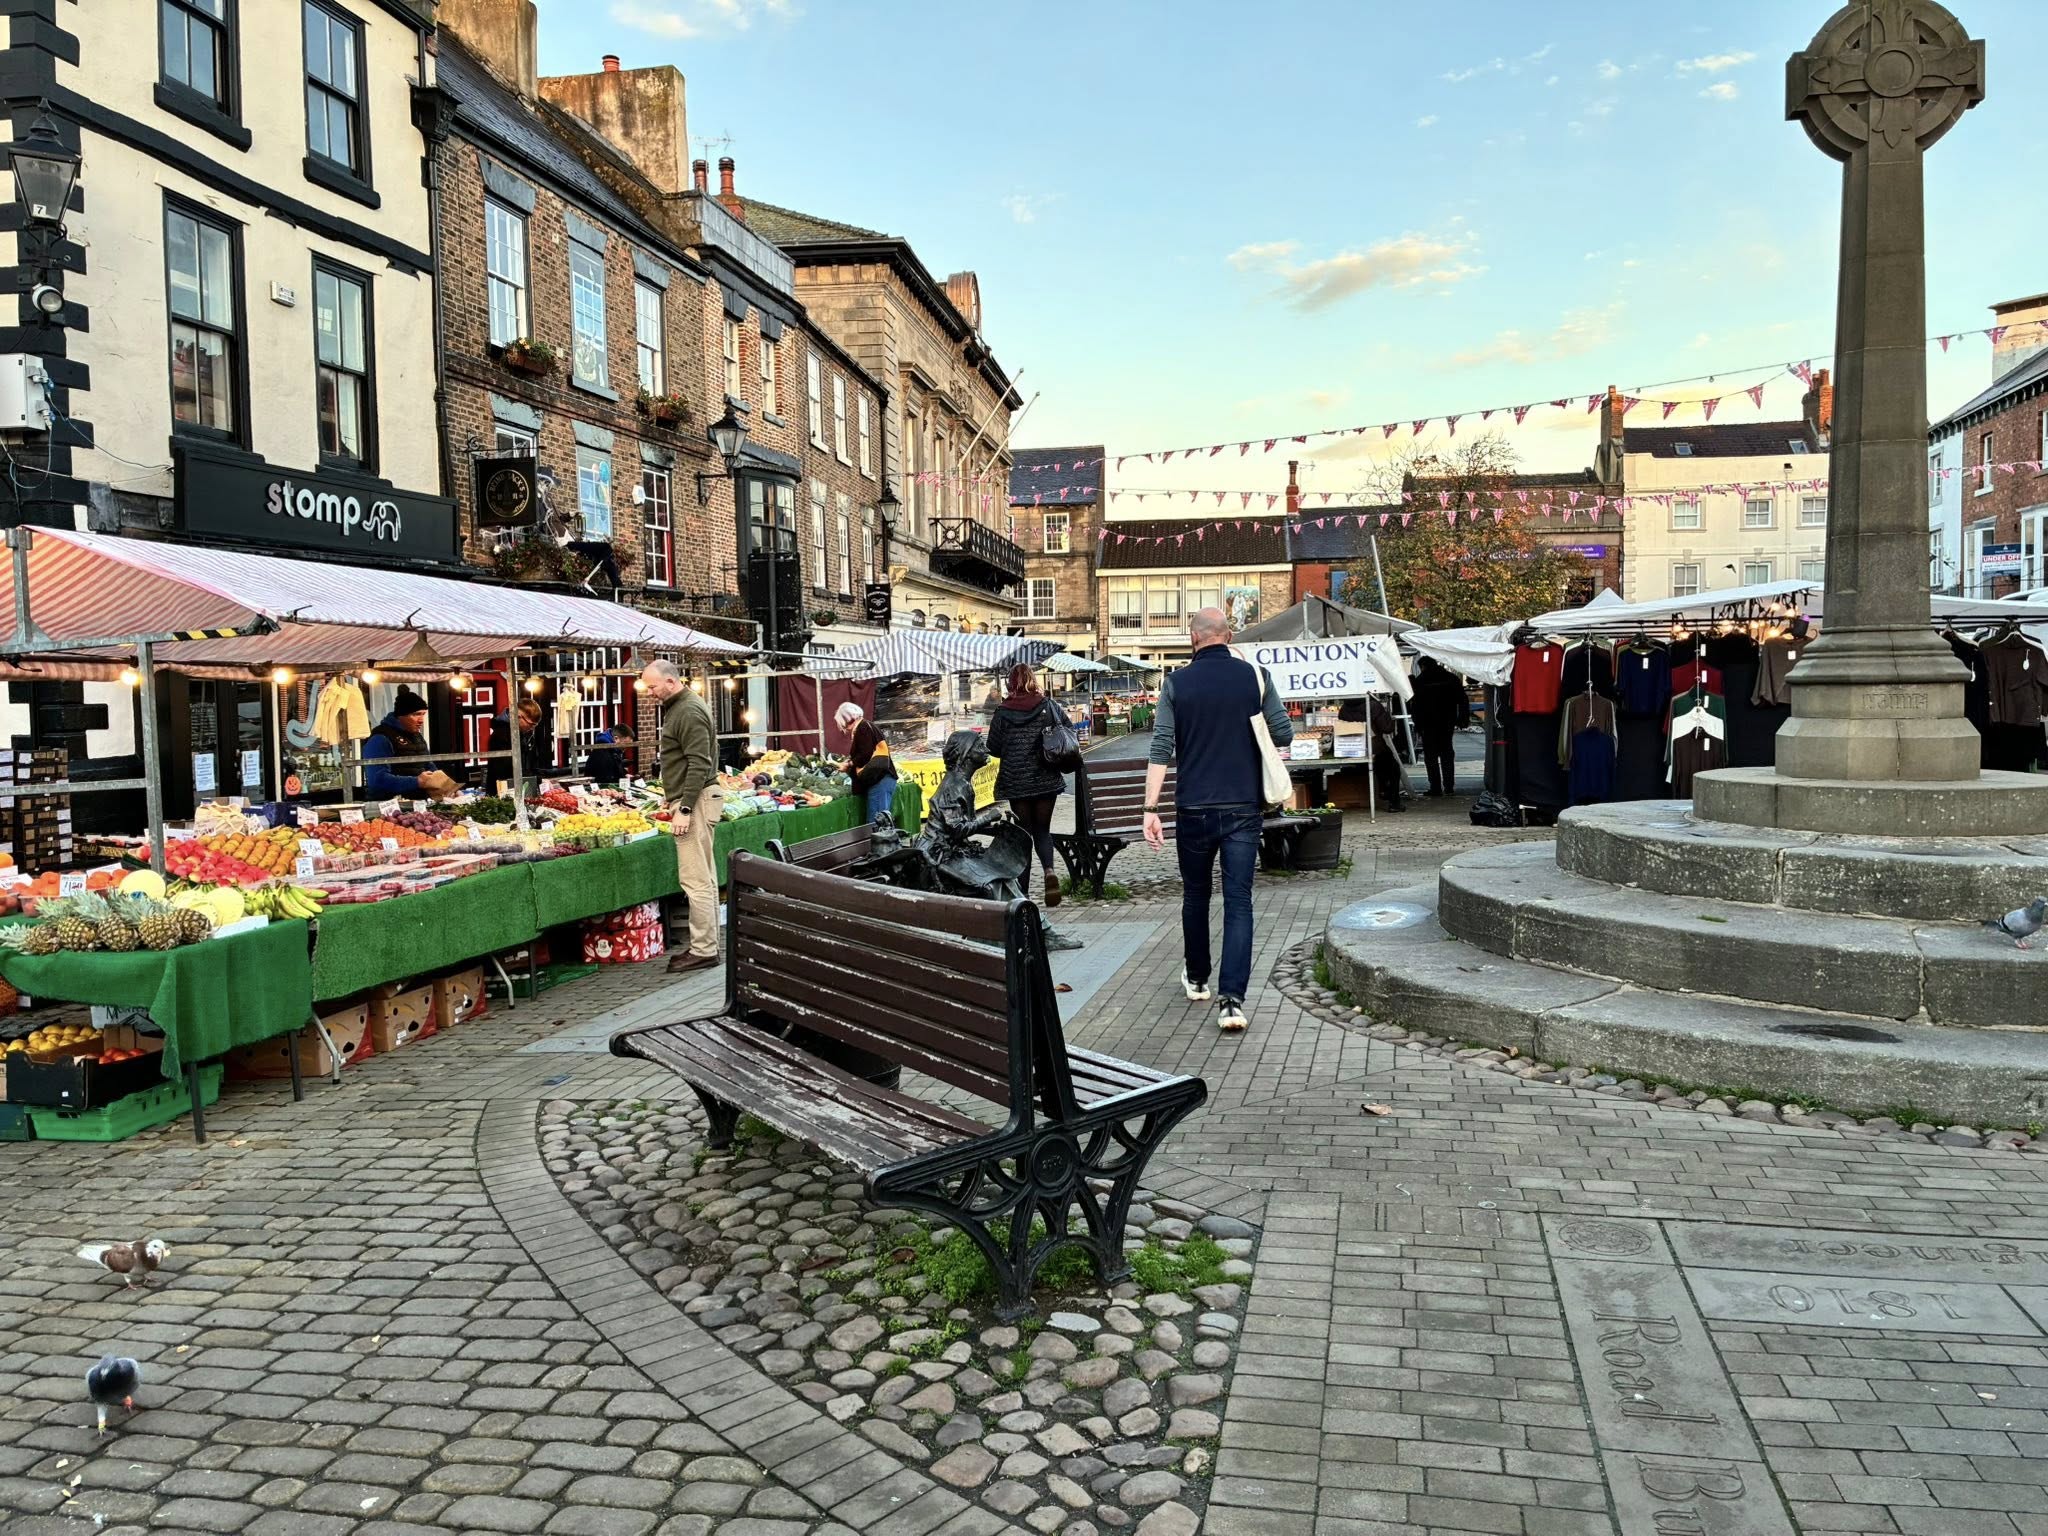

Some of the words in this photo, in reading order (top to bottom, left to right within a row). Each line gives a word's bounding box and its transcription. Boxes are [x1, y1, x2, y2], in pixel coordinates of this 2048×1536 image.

[266, 480, 361, 536] stomp
[1256, 641, 1377, 665] CLINTON'S
[1288, 671, 1347, 690] EGGS
[1768, 1284, 1972, 1320] 1810
[1591, 1309, 1721, 1425] Road
